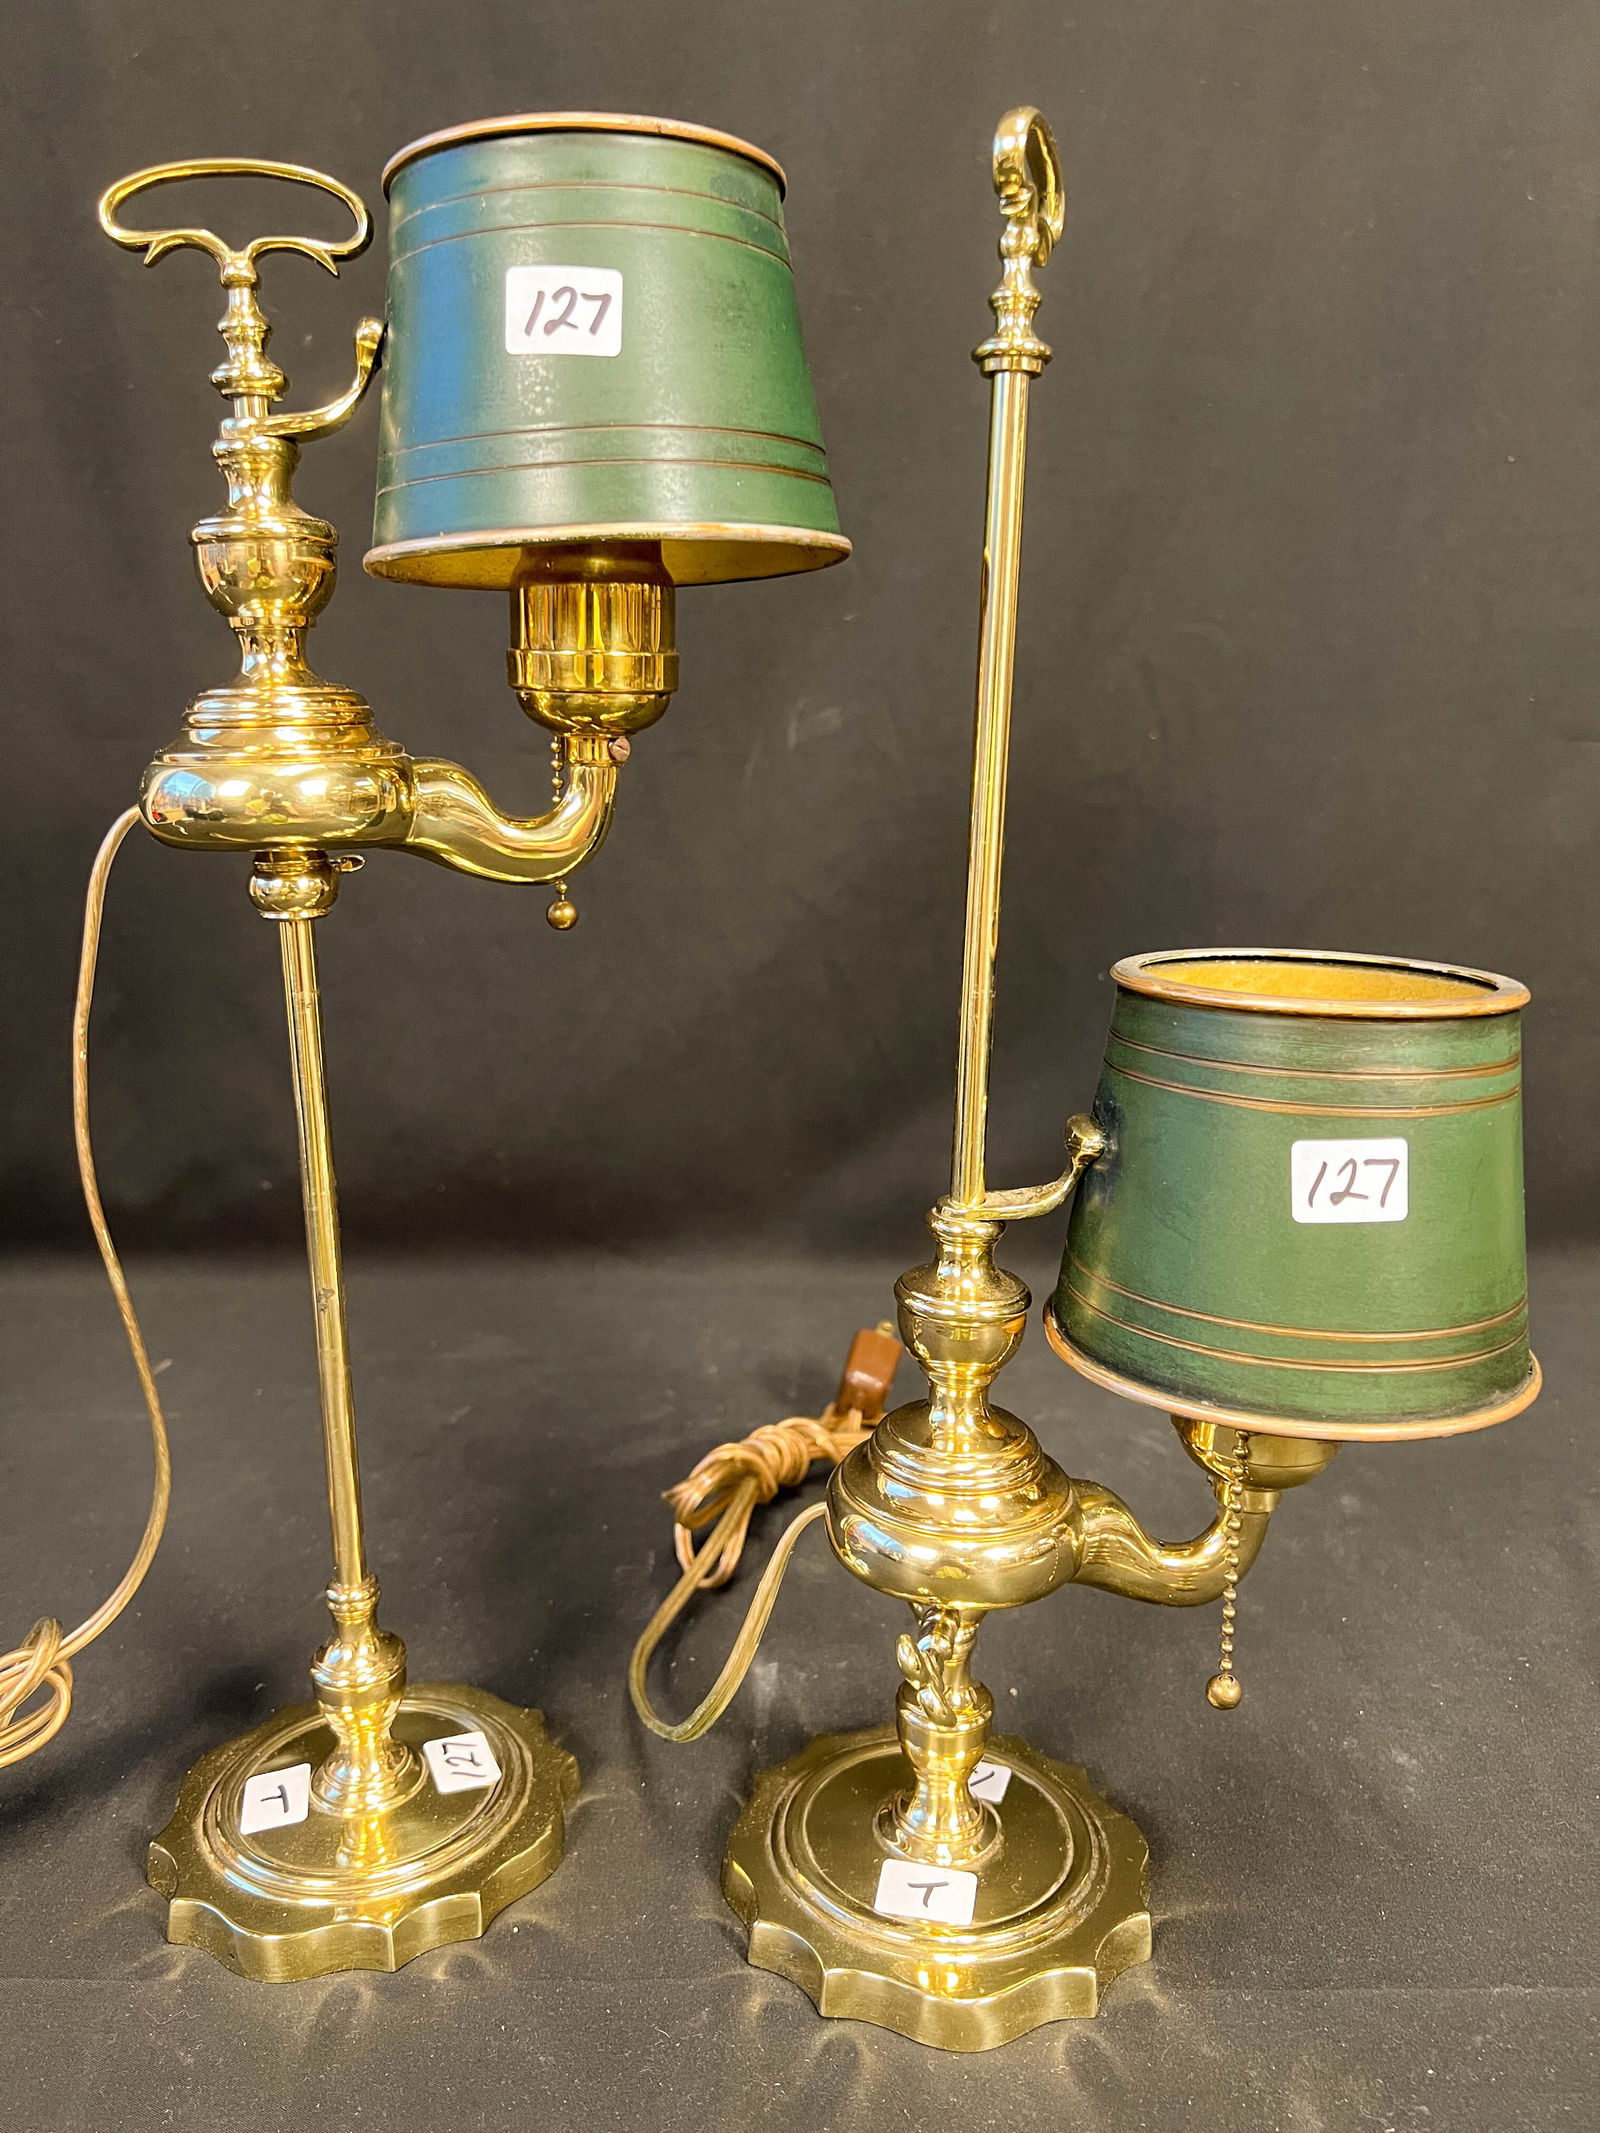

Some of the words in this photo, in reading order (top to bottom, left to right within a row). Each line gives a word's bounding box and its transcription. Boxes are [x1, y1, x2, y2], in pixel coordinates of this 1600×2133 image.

[524, 285, 612, 336] 127
[1308, 1157, 1400, 1208] 127
[442, 1742, 487, 1778] 127
[260, 1784, 289, 1813] T
[907, 1881, 949, 1908] T
